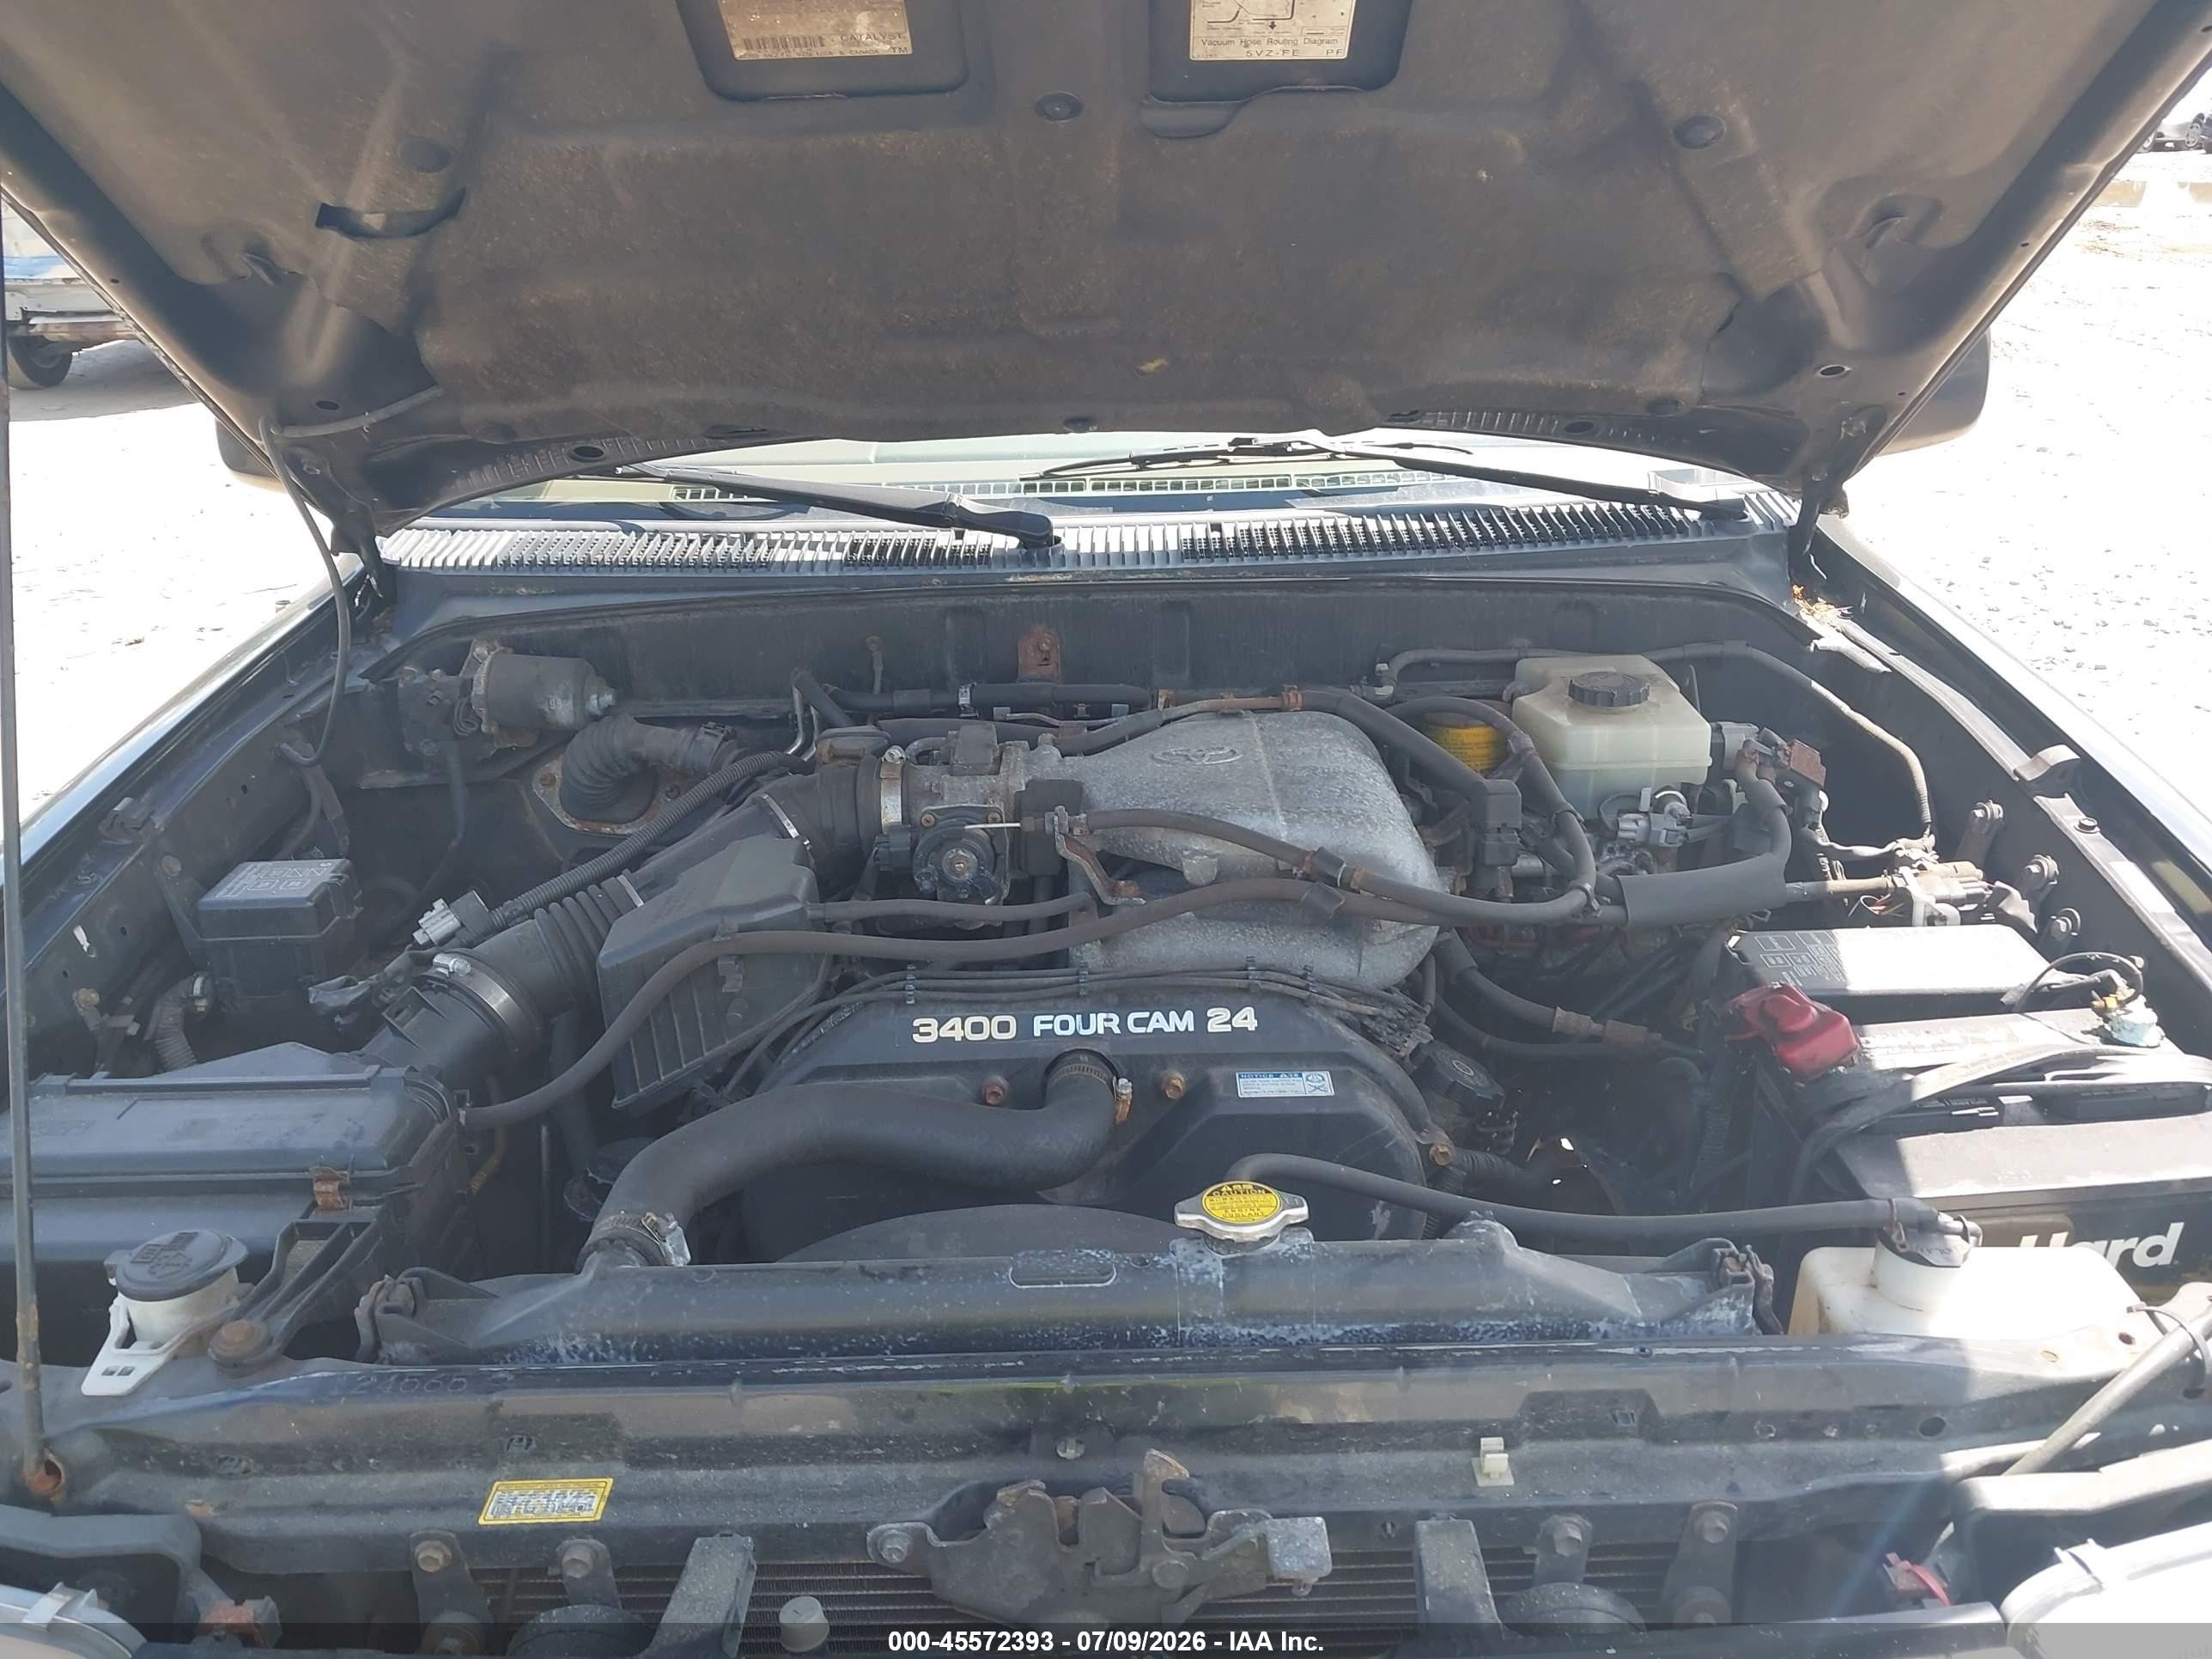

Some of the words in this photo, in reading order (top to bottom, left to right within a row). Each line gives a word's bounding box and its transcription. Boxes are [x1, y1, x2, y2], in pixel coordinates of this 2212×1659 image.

[1200, 38, 1235, 46] Vacuum
[1239, 37, 1261, 47] Hose
[1267, 37, 1299, 47] Routing
[1303, 37, 1339, 47] Diagram
[1245, 49, 1300, 58] 5VZ-FE
[912, 1015, 1017, 1042] 3400
[1033, 1012, 1121, 1036] FOUR
[1127, 1010, 1194, 1033] CAM
[1206, 1006, 1257, 1031] 24
